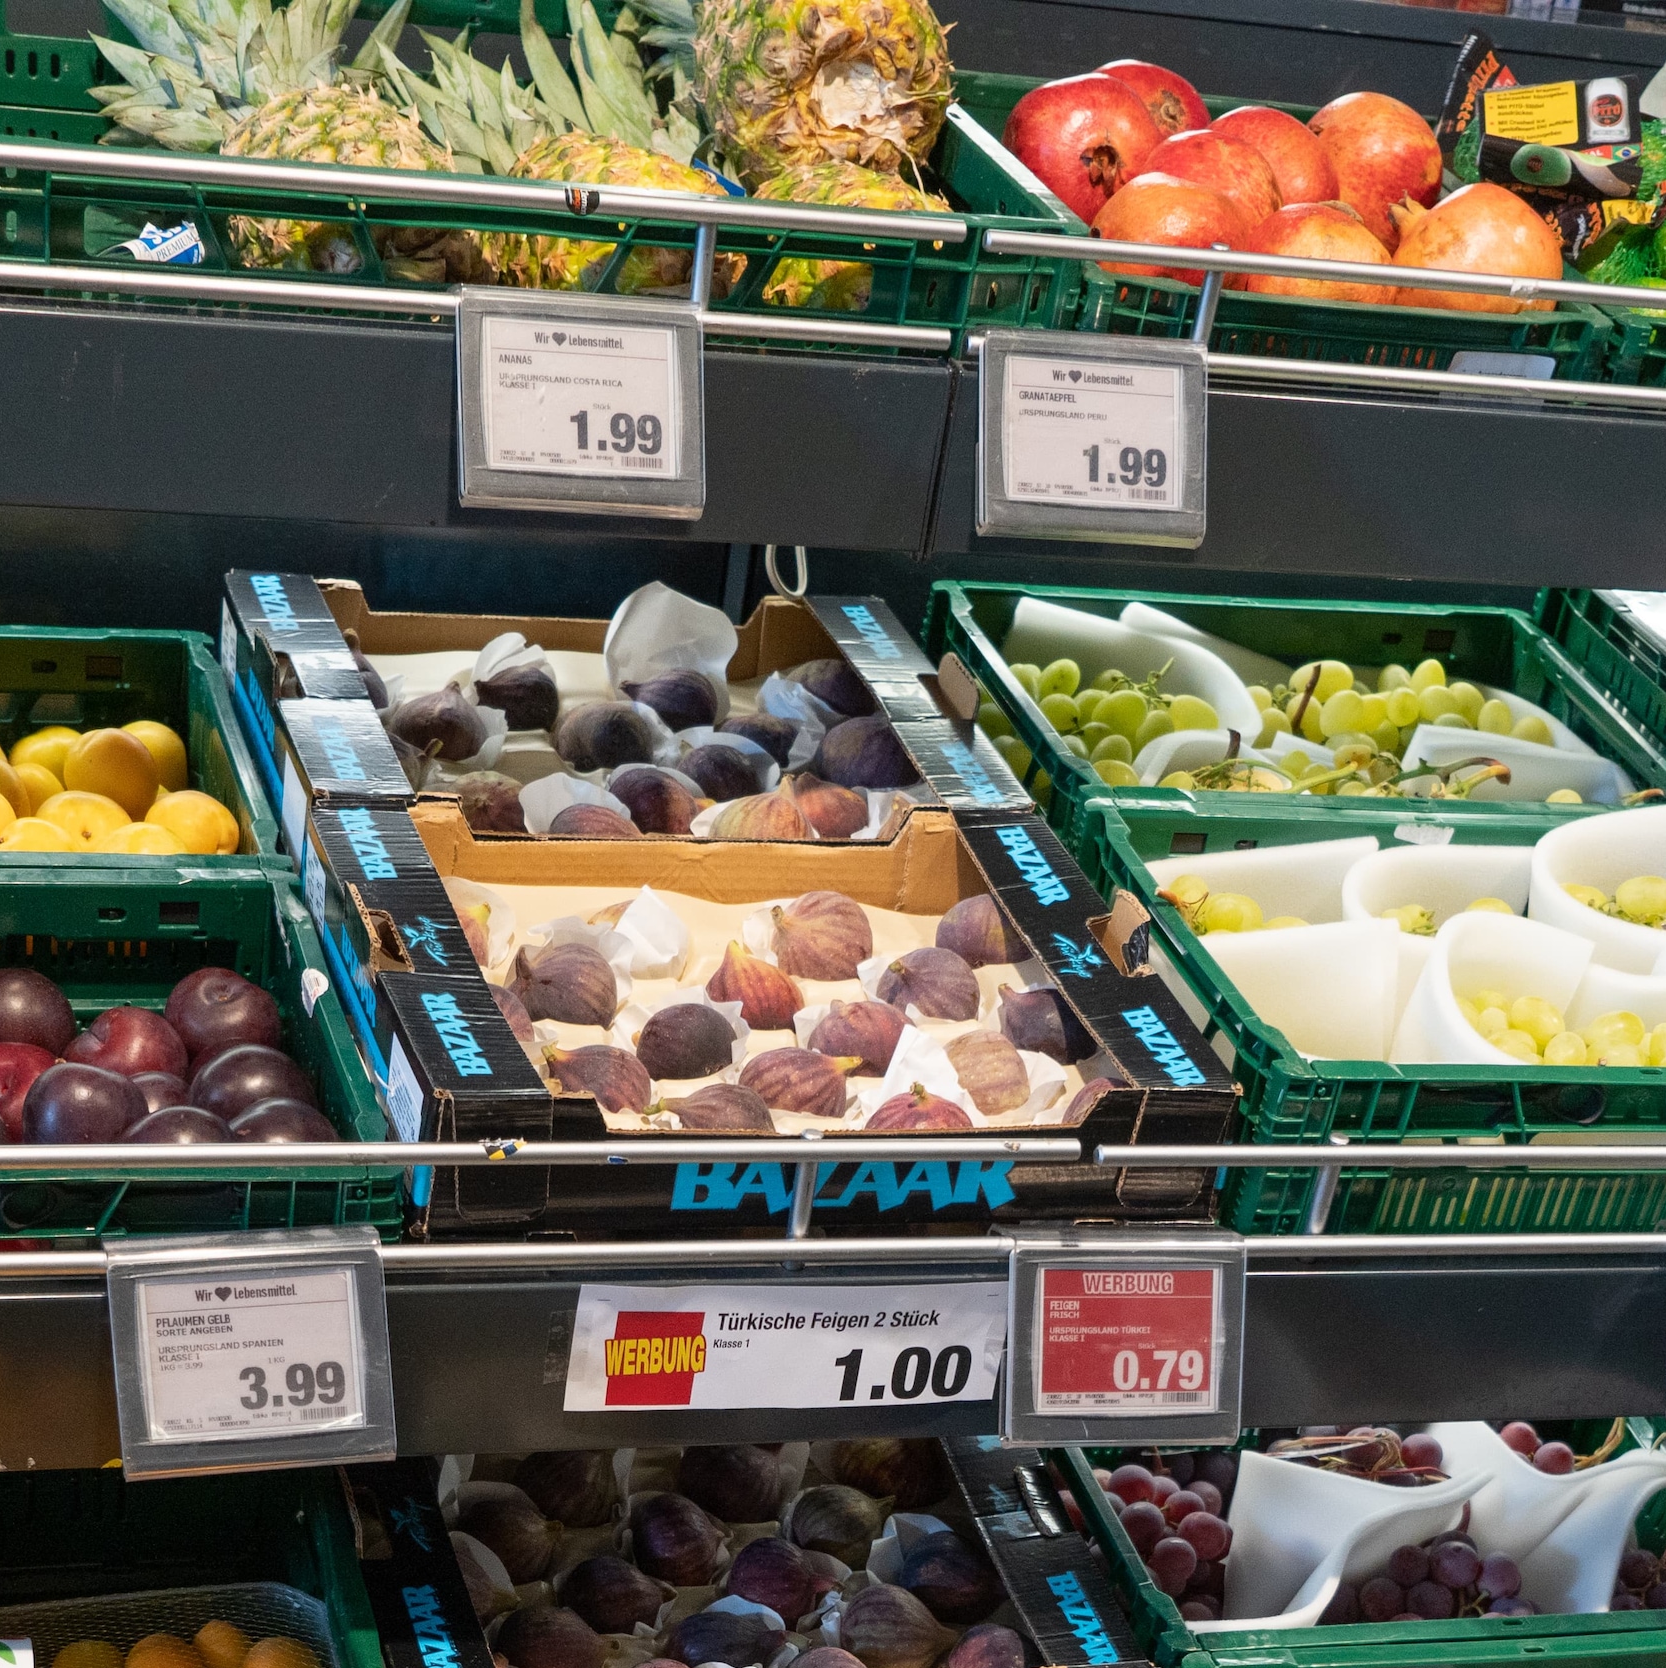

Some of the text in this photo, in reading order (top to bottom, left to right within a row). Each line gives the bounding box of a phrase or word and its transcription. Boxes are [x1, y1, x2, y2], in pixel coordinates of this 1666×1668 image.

[156, 232, 195, 262] PREMIUM
[534, 332, 549, 346] Wir
[499, 354, 532, 366] ANANAS
[573, 376, 623, 388] COSTA RICA
[1019, 390, 1076, 403] GRANATAEPFEL
[570, 410, 662, 455] 1.99
[1082, 445, 1166, 487] 1.99
[249, 573, 299, 633] BAZAAR
[840, 603, 901, 659] BAZAAR
[337, 806, 399, 882] BAZAAR
[995, 825, 1070, 907] BAZAAR
[421, 992, 492, 1077] BAZAAR
[1121, 1004, 1207, 1087] BAZAAR
[195, 1289, 213, 1301] Wir
[1082, 1273, 1174, 1296] WERBUNG
[1050, 1301, 1080, 1311] FEIGEN
[1050, 1311, 1080, 1320] FRISCH
[156, 1314, 231, 1328] PFLAUMEN GELB
[156, 1325, 233, 1337] SORTE ANGEBEN
[718, 1309, 940, 1333] Türkische Feigen 2 Stück
[1049, 1324, 1151, 1336] URSPRUNGSLAND TÜRKEI
[159, 1339, 284, 1354] URSPRUNGSLAND SPANIEN
[713, 1339, 739, 1350] Klasse
[1049, 1335, 1076, 1343] KLASSE
[159, 1353, 192, 1363] KLASSE
[606, 1334, 707, 1379] WERBUNG
[835, 1345, 973, 1401] 1.00
[1113, 1349, 1204, 1391] 0.79
[239, 1362, 345, 1410] 3.99
[1046, 1570, 1119, 1665] BAZAAR
